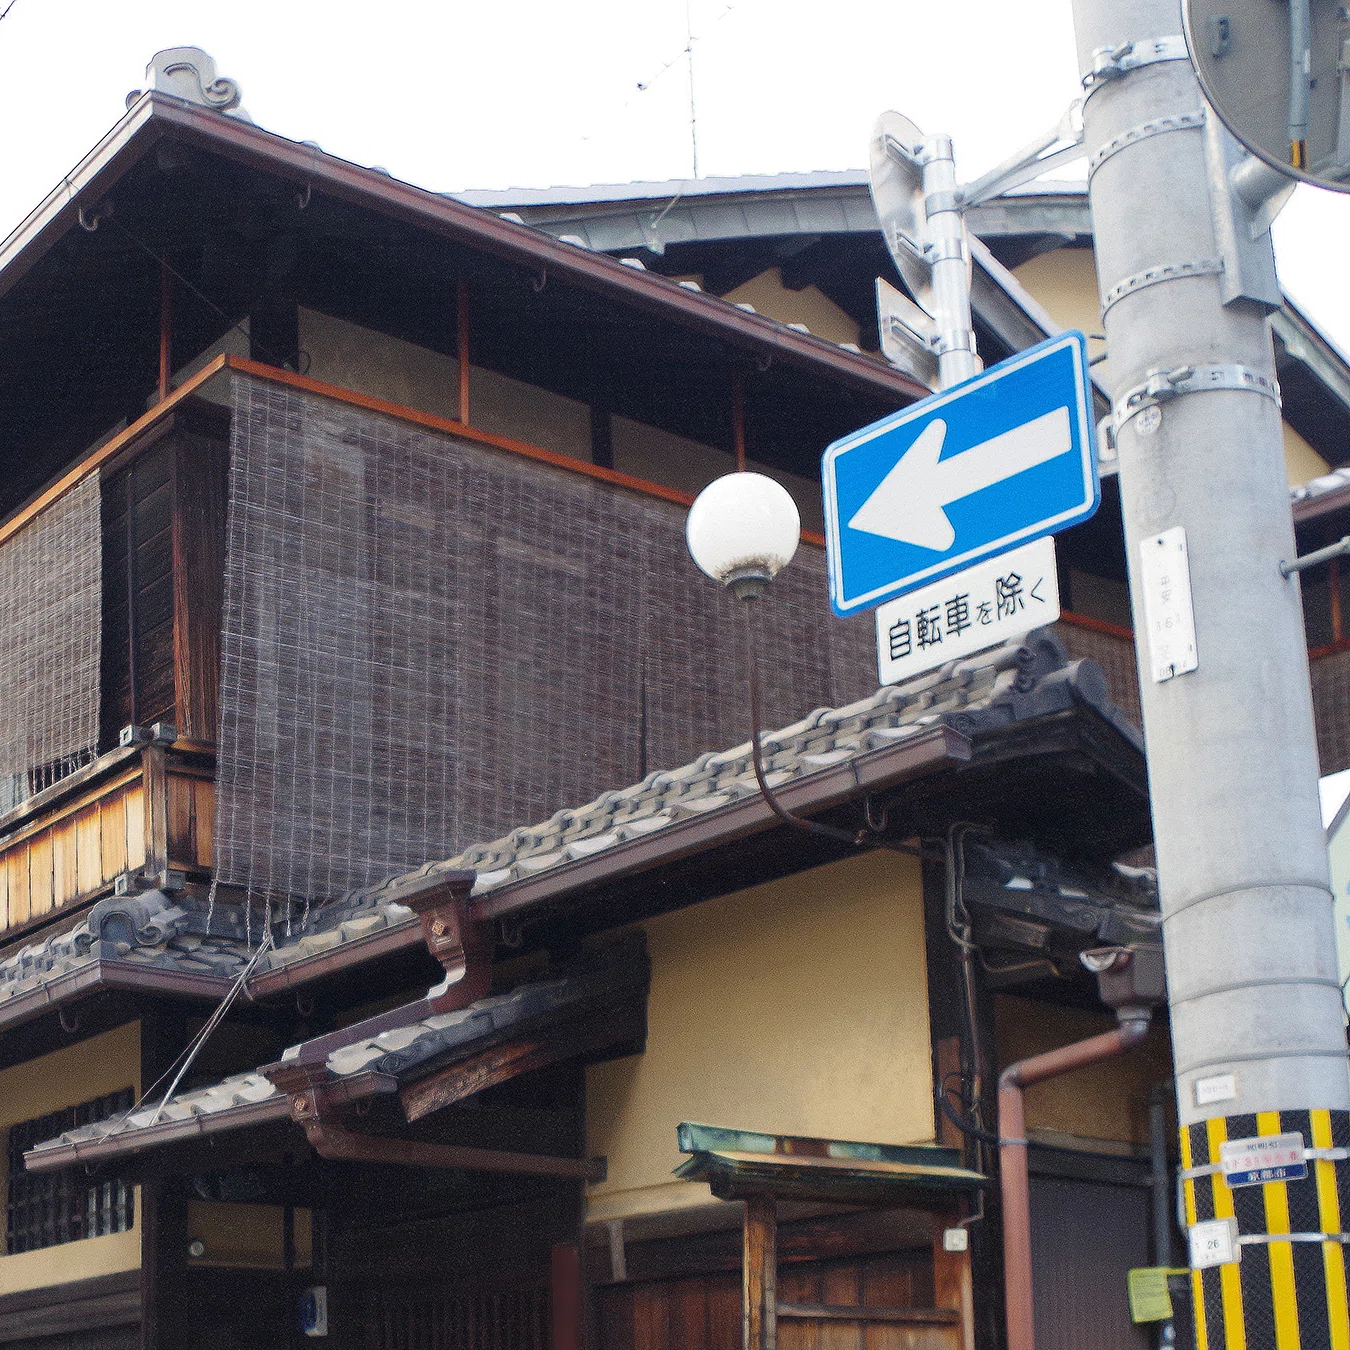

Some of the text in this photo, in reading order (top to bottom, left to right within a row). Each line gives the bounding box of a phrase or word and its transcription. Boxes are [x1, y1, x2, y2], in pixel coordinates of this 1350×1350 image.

[888, 570, 1046, 662] 自転車を除く
